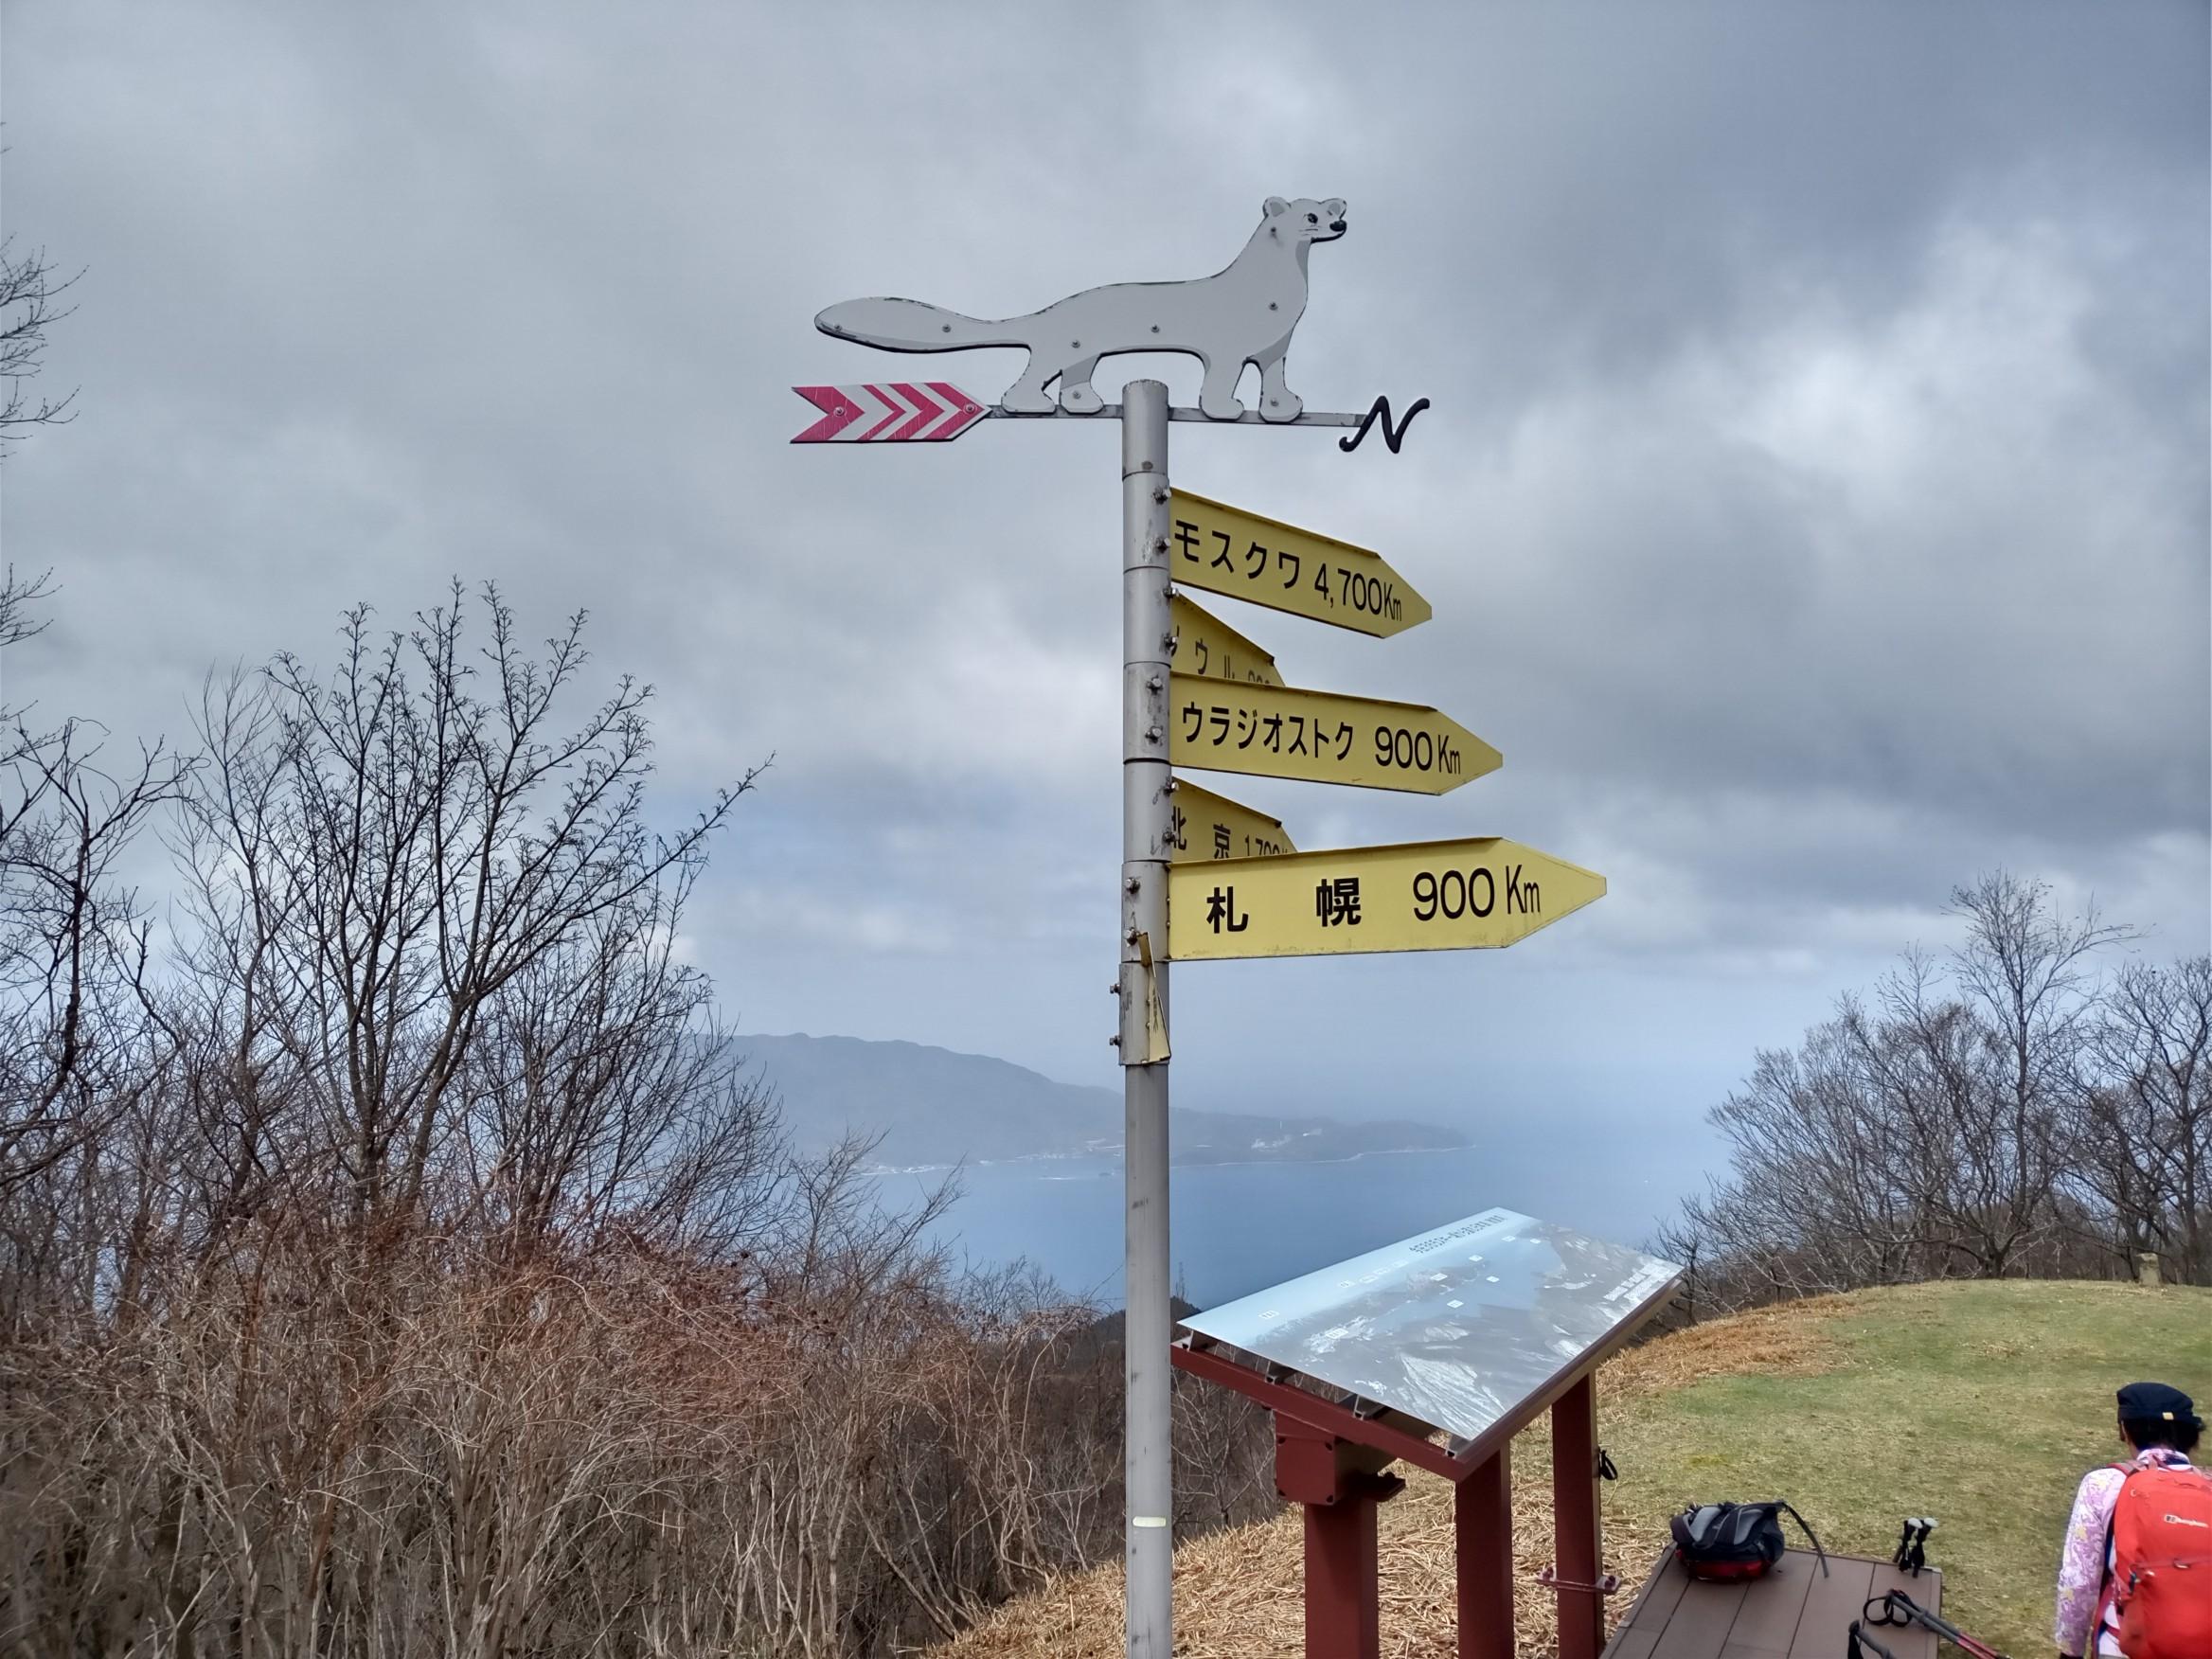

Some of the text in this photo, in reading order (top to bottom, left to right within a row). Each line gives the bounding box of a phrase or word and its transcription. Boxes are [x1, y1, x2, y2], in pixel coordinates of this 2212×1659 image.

[1339, 396, 1430, 454] N
[1174, 520, 1301, 589] モスクワ
[1183, 702, 1353, 760] ウラジオストク
